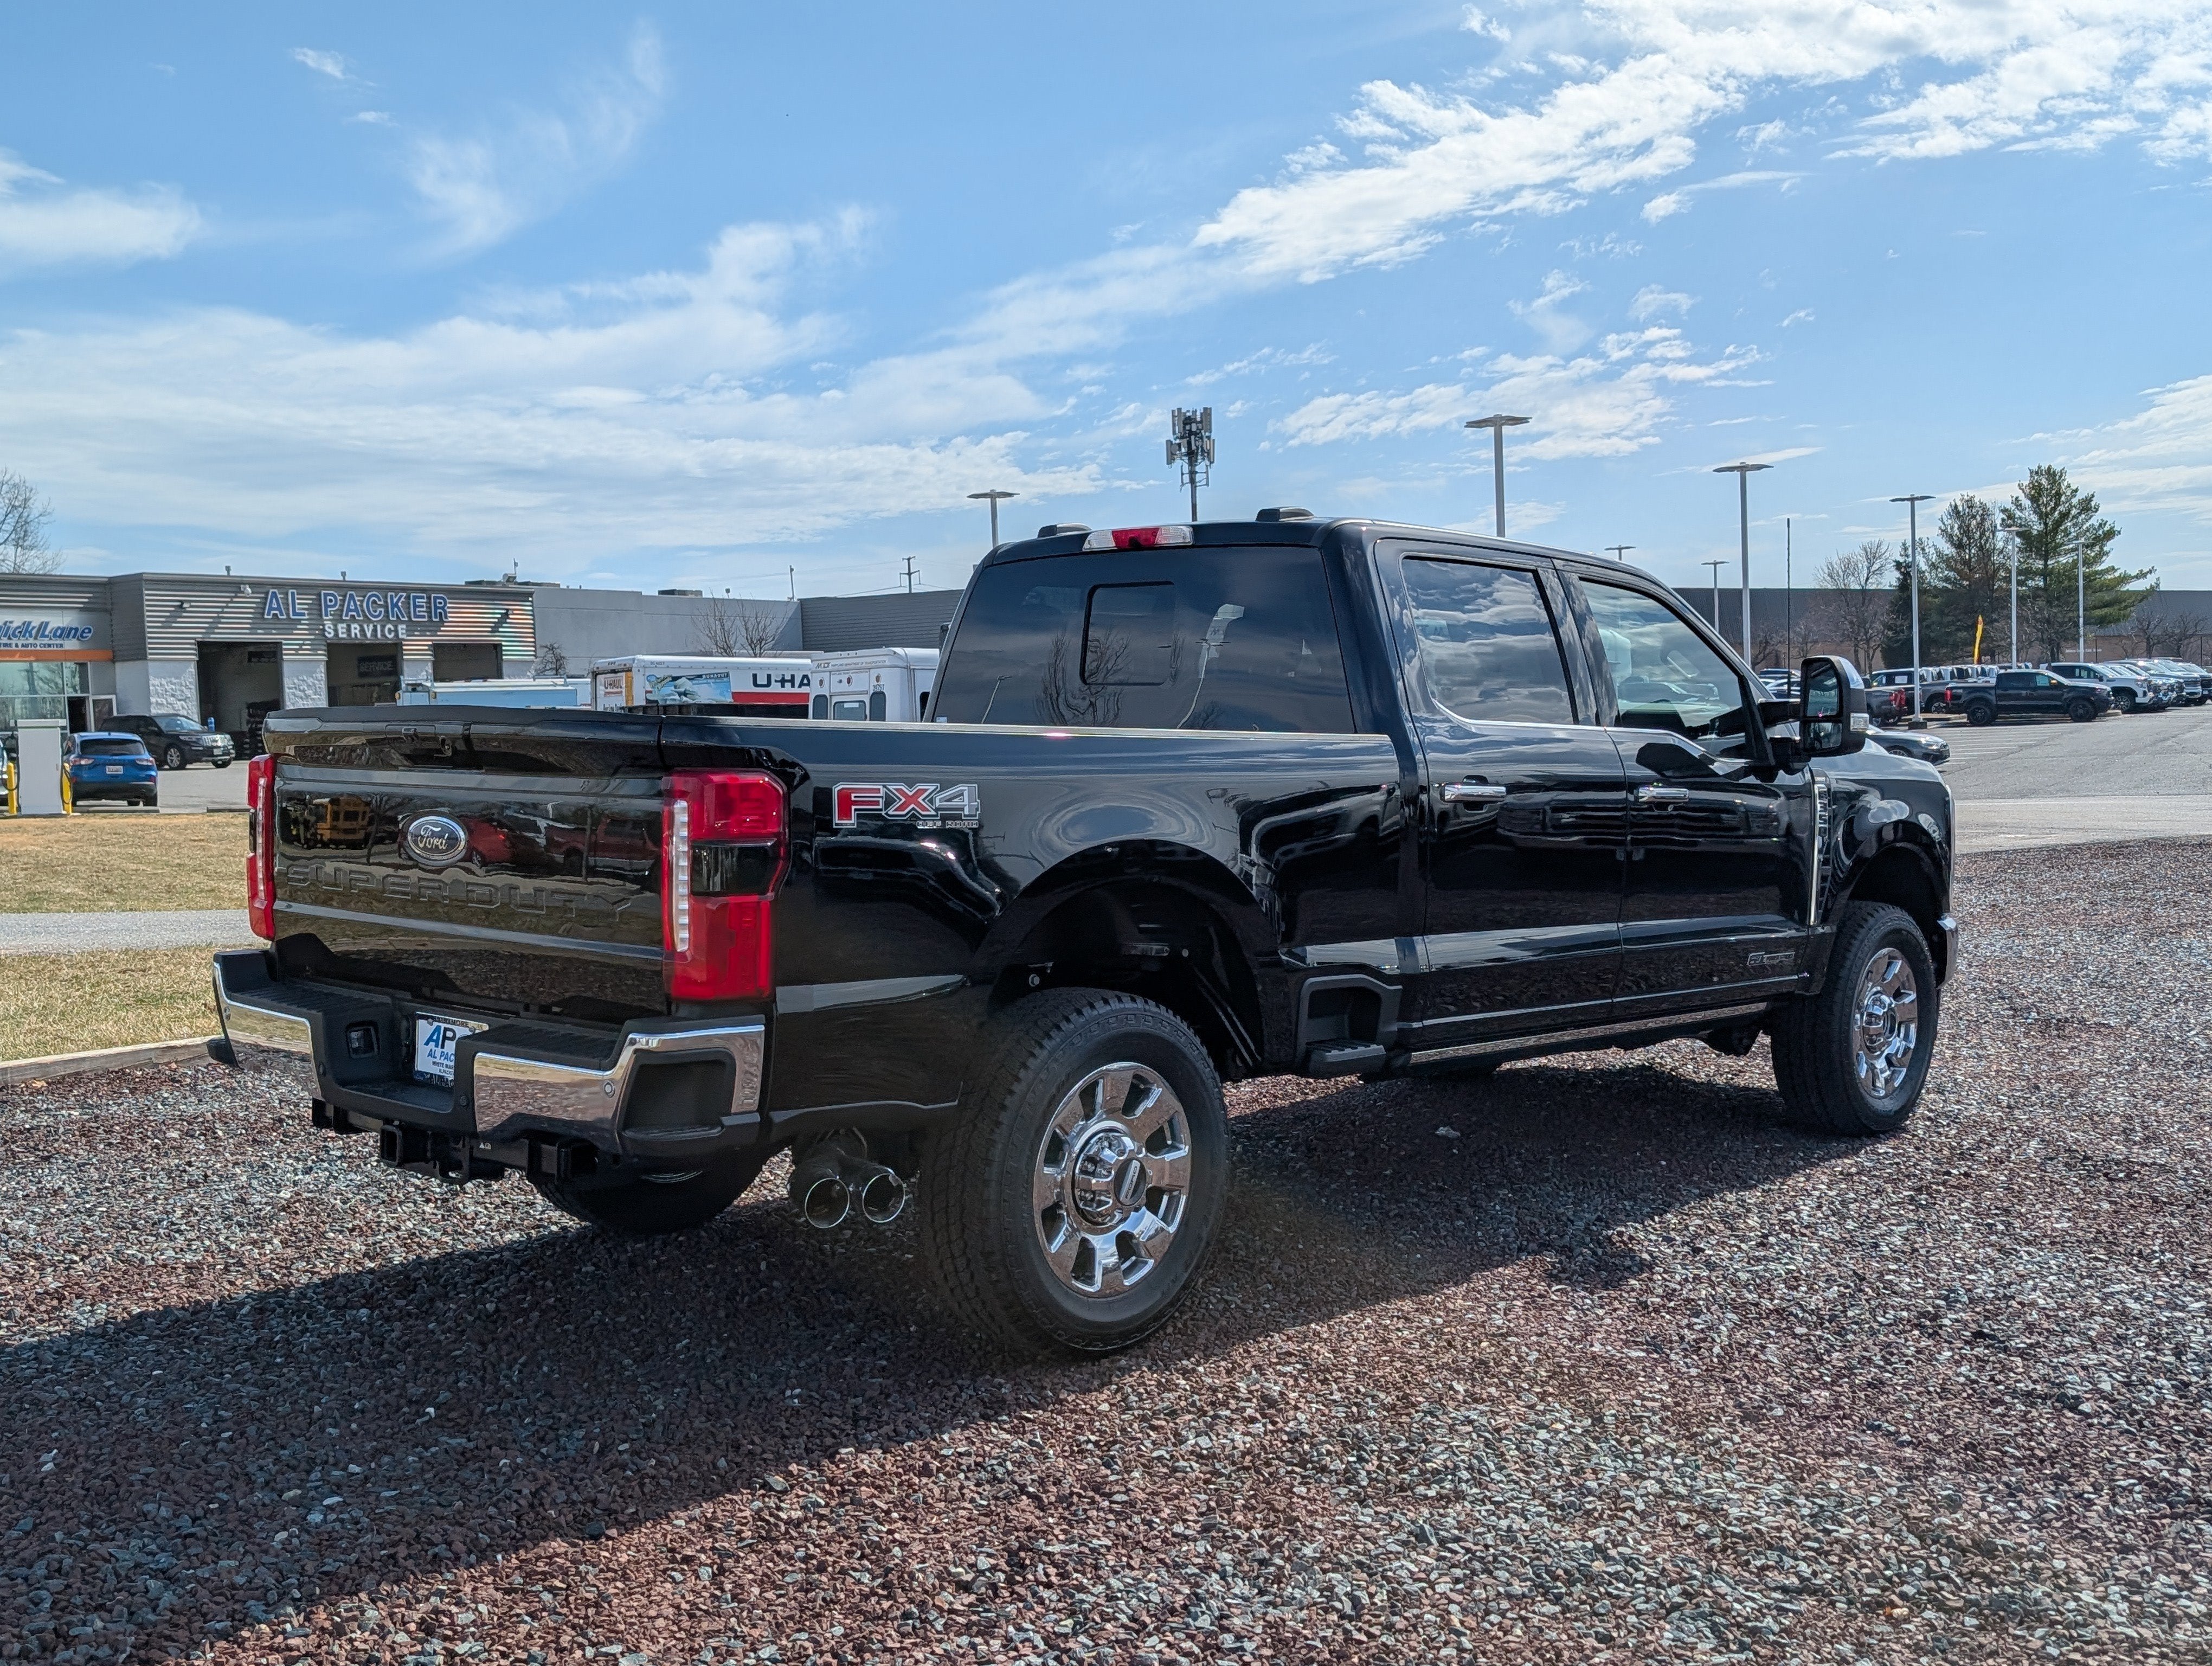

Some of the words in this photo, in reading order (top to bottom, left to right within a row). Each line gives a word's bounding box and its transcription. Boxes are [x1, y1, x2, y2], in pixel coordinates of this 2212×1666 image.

[265, 589, 307, 619] AL
[321, 590, 449, 621] PACKER
[37, 621, 93, 640] Lane
[325, 624, 407, 639] SERVICE
[833, 782, 980, 828] FX4
[418, 825, 448, 850] Ford
[286, 863, 449, 904] SUPER
[466, 881, 632, 921] DUTY
[423, 1025, 457, 1049] AP
[427, 1048, 437, 1059] AL
